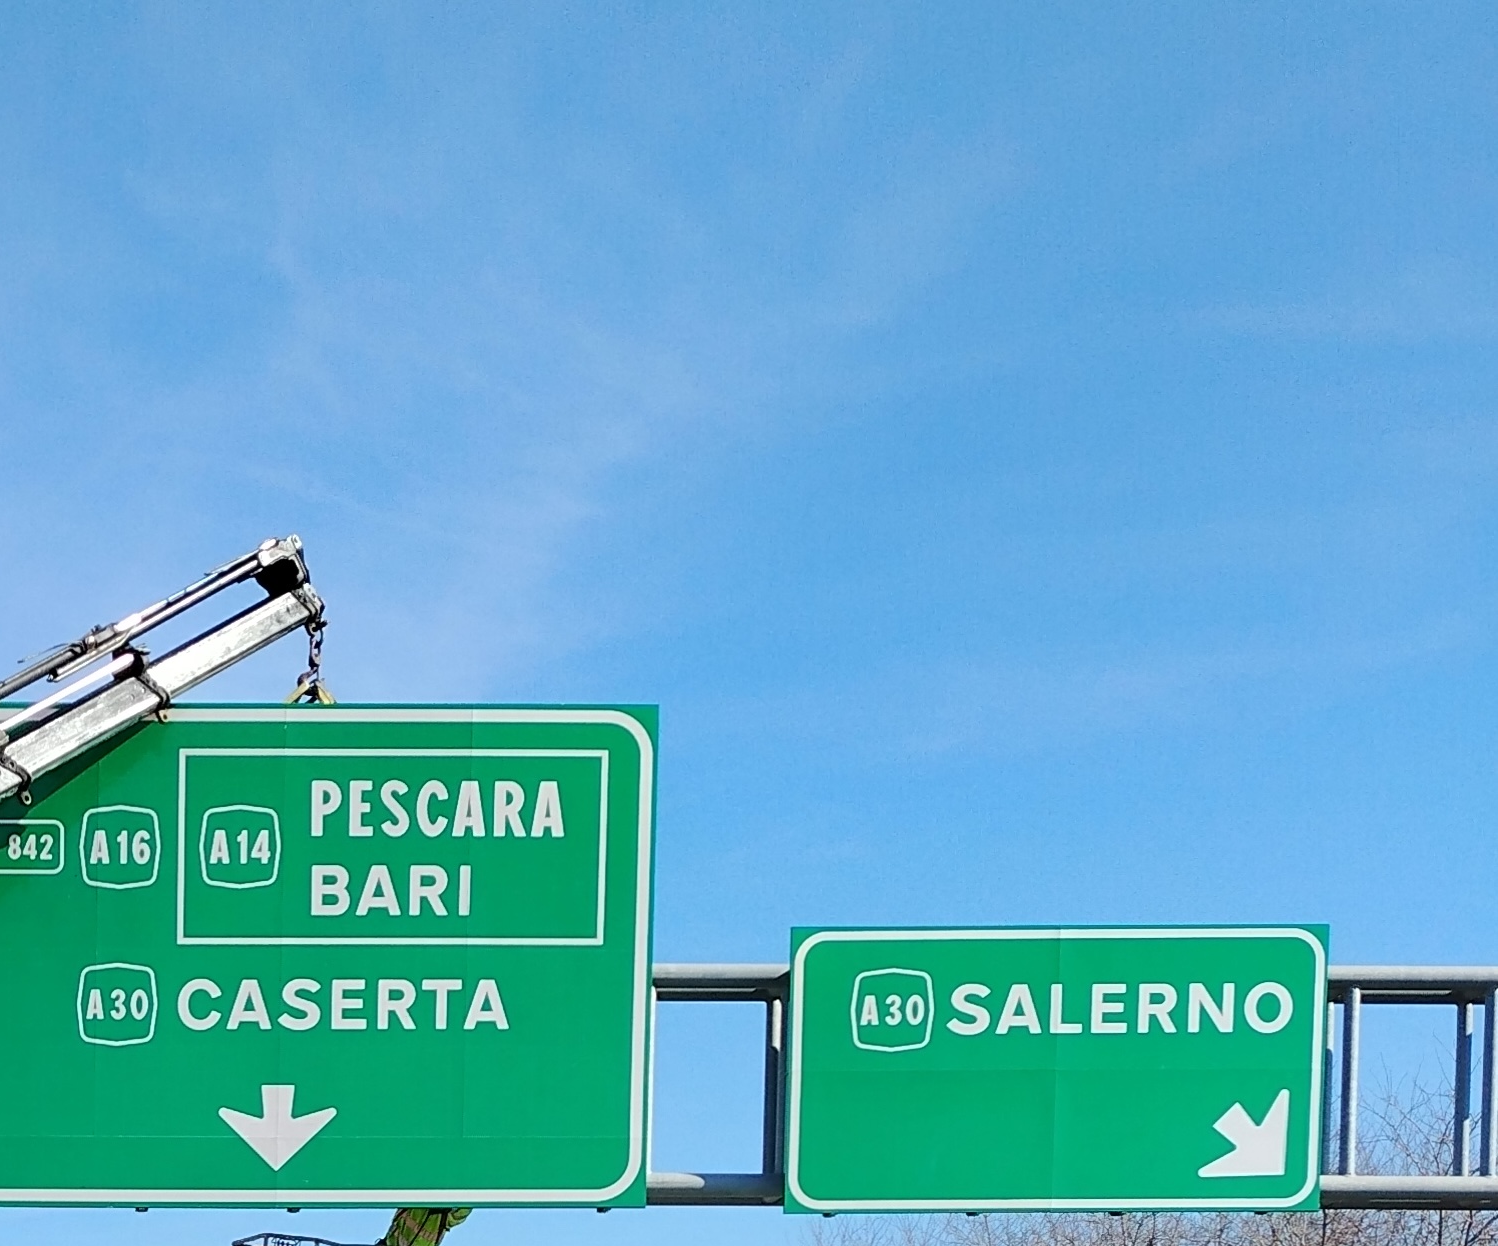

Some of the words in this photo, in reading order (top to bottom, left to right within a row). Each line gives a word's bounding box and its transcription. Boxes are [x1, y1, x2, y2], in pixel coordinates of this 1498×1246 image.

[309, 779, 565, 838] PESCARA
[7, 833, 54, 860] 842
[89, 829, 151, 865] A16
[209, 828, 272, 865] A14
[309, 864, 472, 917] BARI
[85, 988, 147, 1021] A30
[177, 977, 510, 1031] CASERTA
[859, 994, 926, 1026] A30
[945, 981, 1294, 1036] SALERNO
